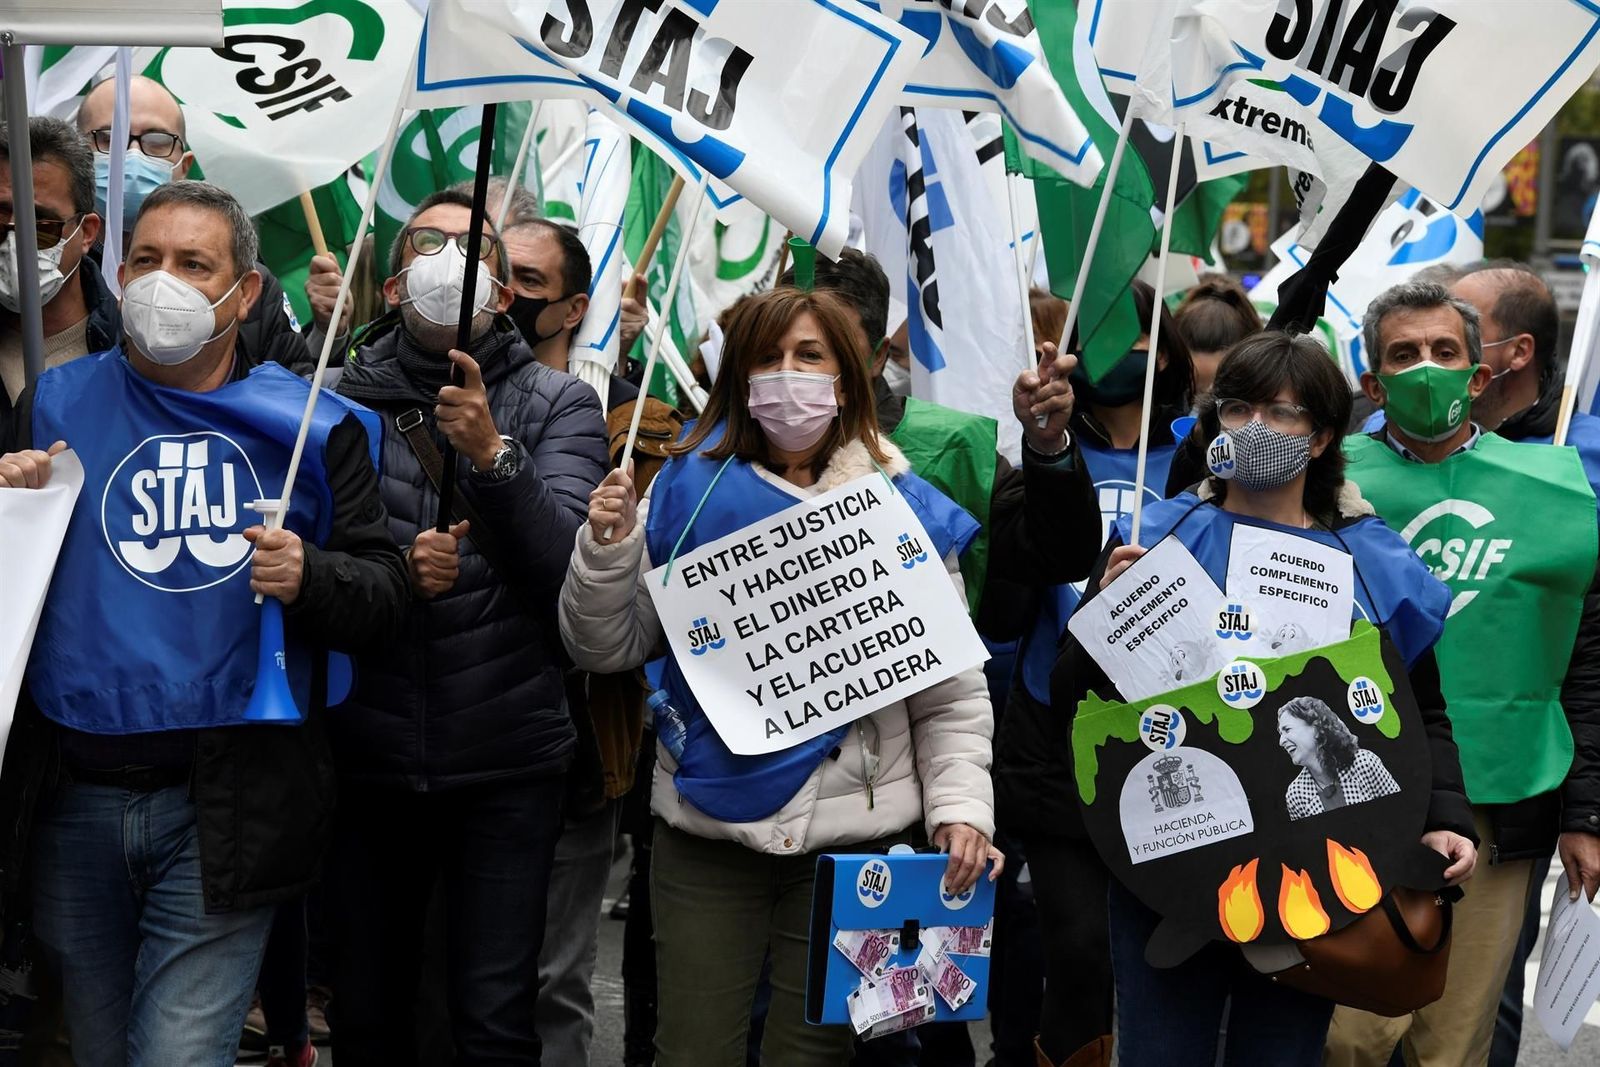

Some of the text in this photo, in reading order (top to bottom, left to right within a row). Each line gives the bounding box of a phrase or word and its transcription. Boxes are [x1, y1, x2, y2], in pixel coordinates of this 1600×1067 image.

[211, 34, 353, 121] CSIF
[1210, 443, 1231, 465] STAJ
[131, 462, 237, 535] STAJ
[682, 488, 881, 589] ENTRE JUSTICIA
[896, 537, 923, 562] STAJ
[719, 528, 876, 607] Y HACIENDA
[1270, 551, 1325, 573] ACUERDO
[1415, 538, 1513, 582] CSIF
[1109, 574, 1161, 620] ACUERDO
[1250, 566, 1339, 594] COMPLEMENTO
[1259, 585, 1329, 609] ESPECIFICO
[733, 559, 889, 640] EL DINERO A
[1106, 576, 1187, 645] COMPLEMENTO
[688, 622, 721, 647] STAJ
[745, 589, 905, 672] LA CARTERA
[1125, 598, 1189, 653] ESPECIFICO
[1218, 611, 1250, 632] STAJ
[746, 616, 926, 707] Y EL ACUERDO
[765, 648, 942, 739] A LA CALDERA
[1224, 671, 1258, 693] STAJ
[1352, 687, 1378, 709] STAJ
[1148, 711, 1171, 745] STAJ
[1132, 818, 1247, 856] Y FUNCIÓN PÚBLICA
[1154, 811, 1216, 836] HACIENDA
[862, 868, 888, 893] STAJ
[895, 968, 919, 984] 500
